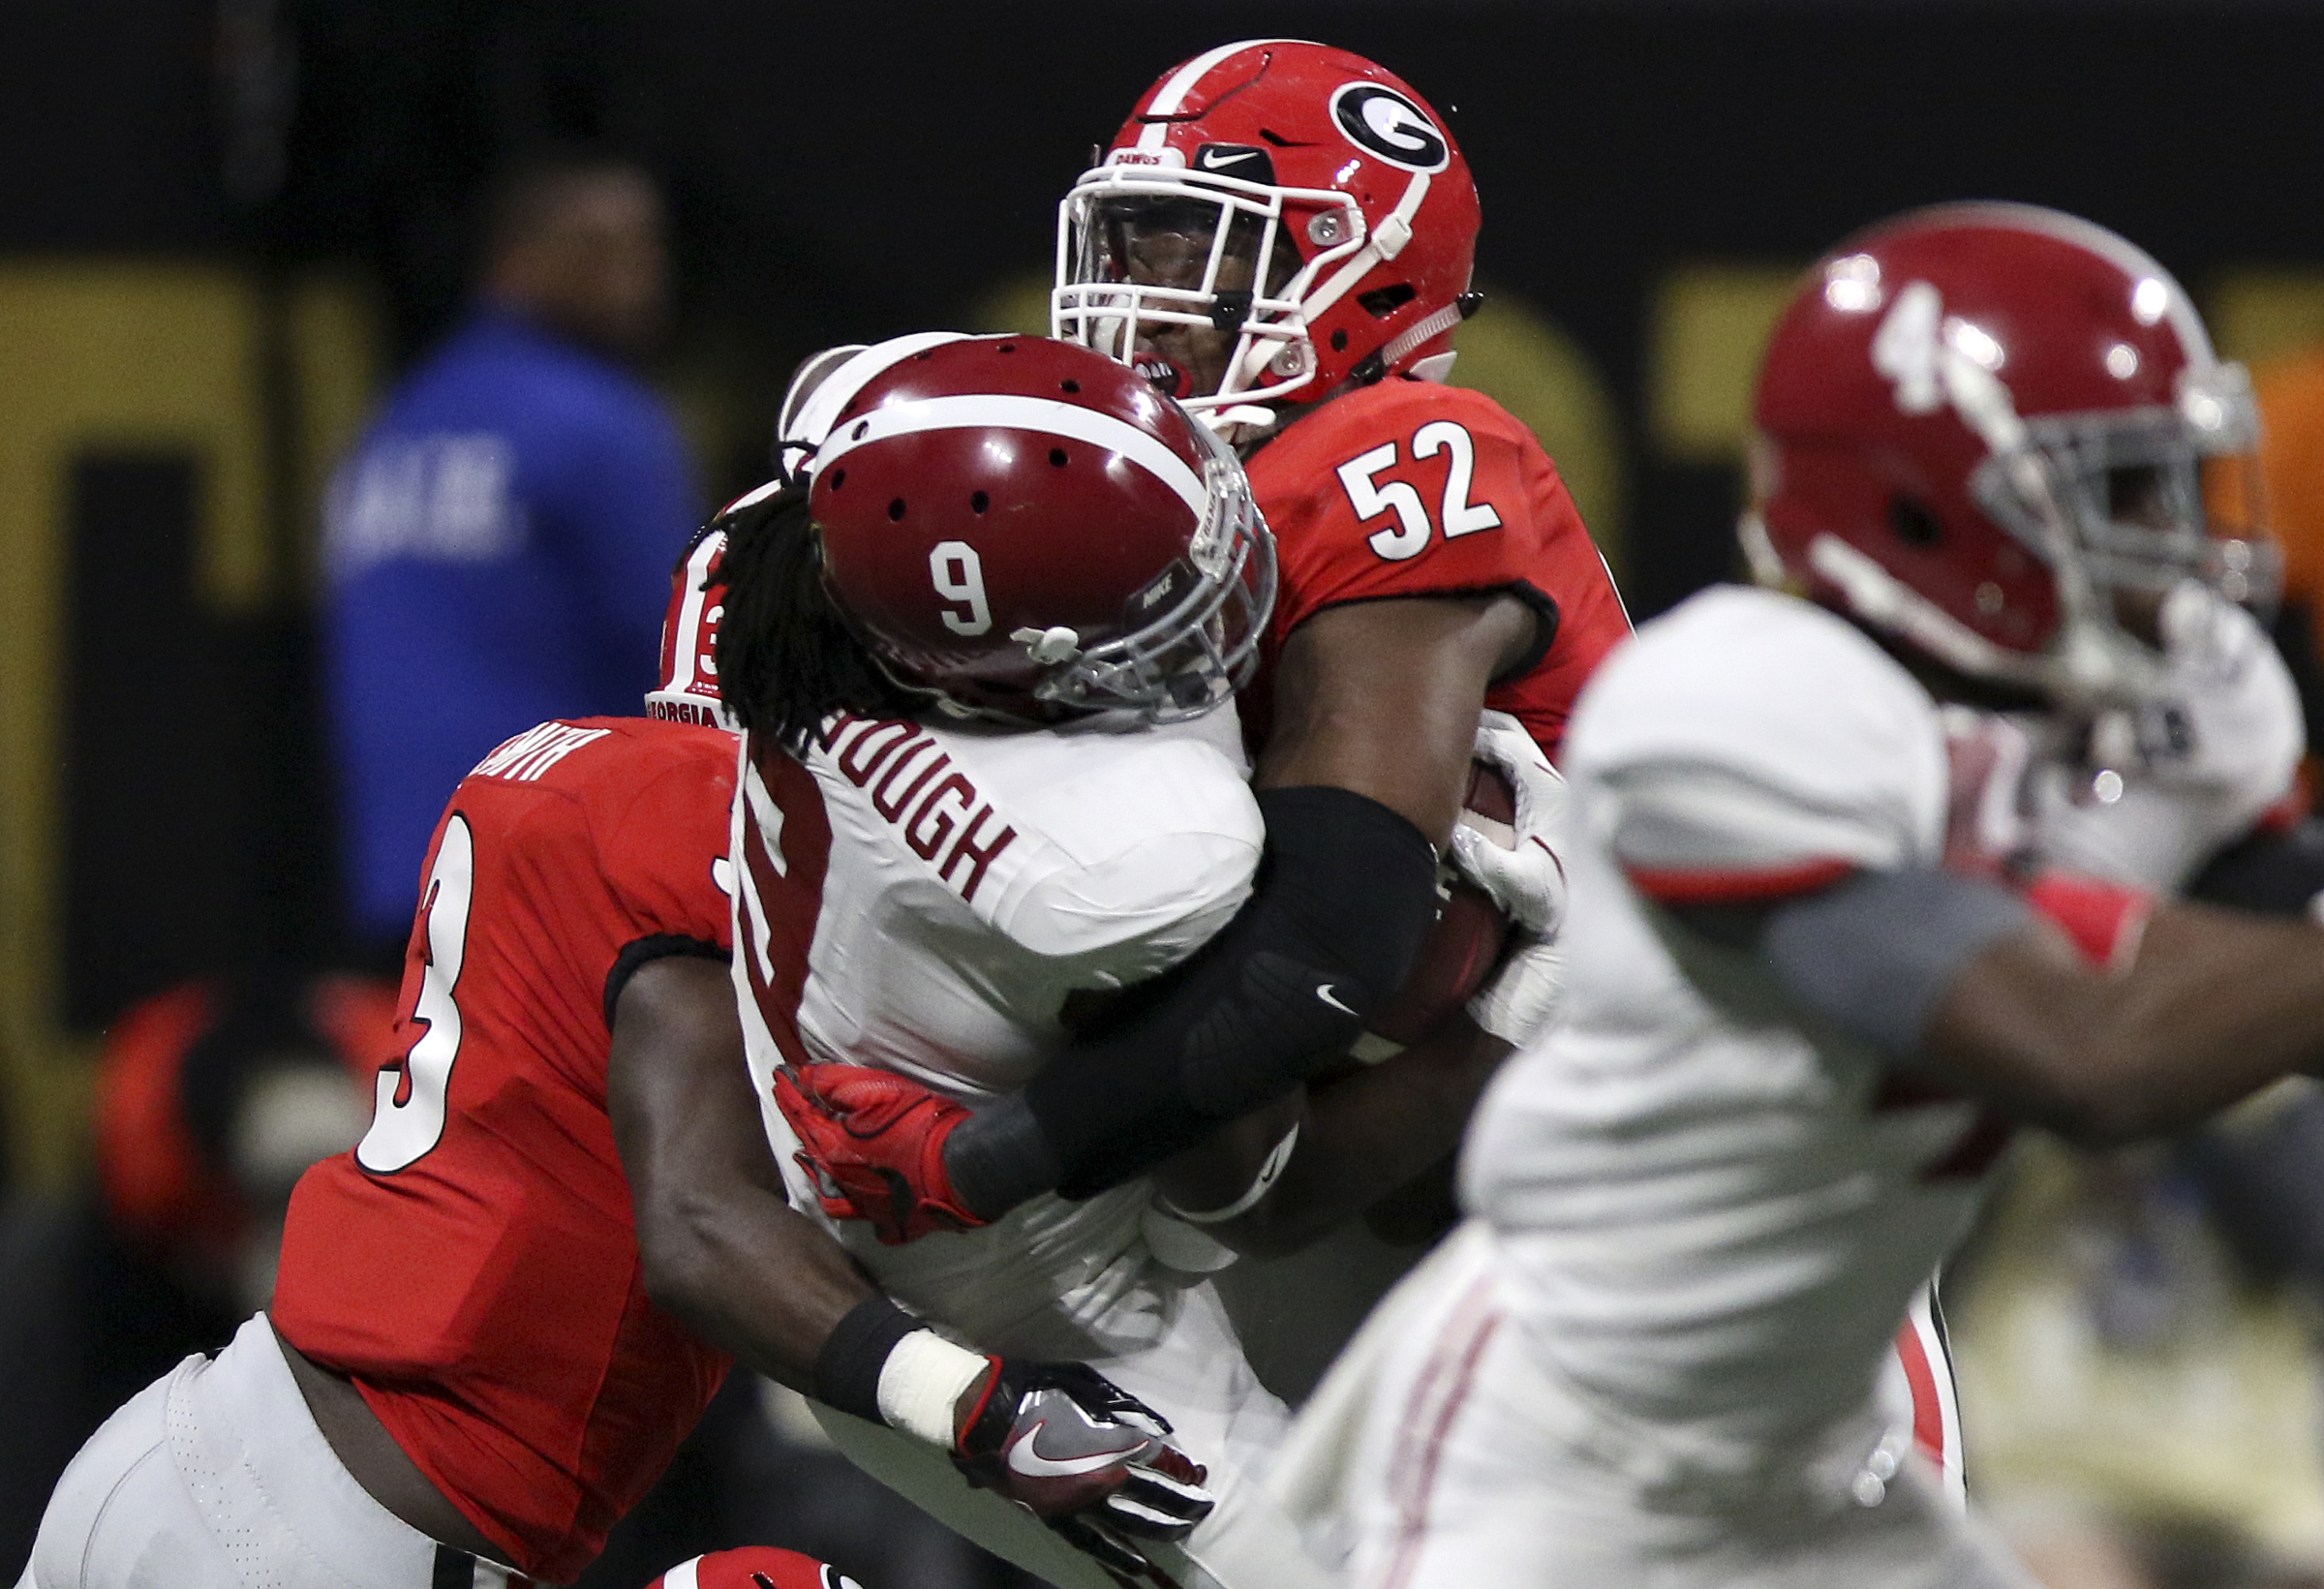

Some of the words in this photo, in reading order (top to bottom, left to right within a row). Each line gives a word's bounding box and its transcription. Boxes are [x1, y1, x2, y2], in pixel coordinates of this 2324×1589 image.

[1870, 281, 1944, 415] 4
[1336, 419, 1503, 562] 52
[929, 540, 993, 636] 9
[1143, 571, 1173, 609] NIKE
[355, 810, 476, 1176] 3
